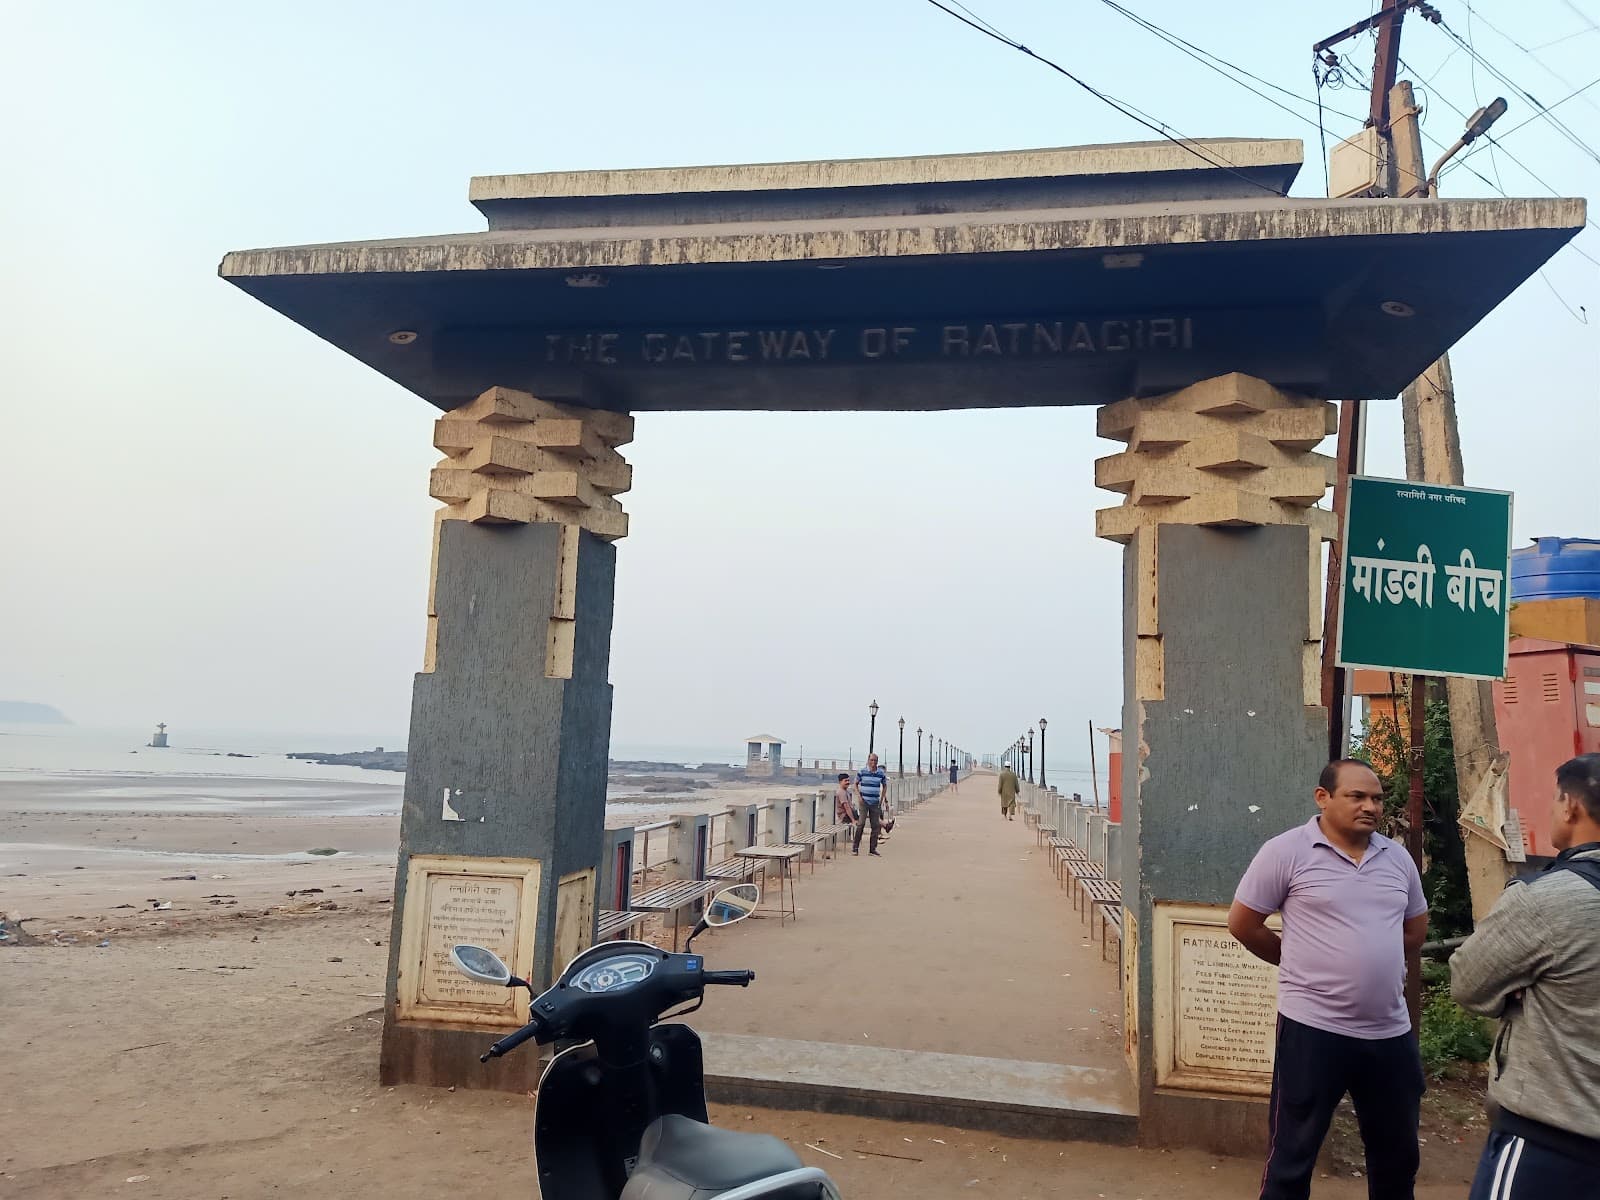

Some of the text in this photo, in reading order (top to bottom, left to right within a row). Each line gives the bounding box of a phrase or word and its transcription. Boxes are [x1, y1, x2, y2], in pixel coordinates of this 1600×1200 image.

[545, 317, 1194, 364] THE GATEWAY OF RATNAGIRI
[1395, 488, 1426, 501] रत्नागिरी
[1350, 537, 1504, 616] मांडवी बीच
[1183, 938, 1242, 951] RATNAGIRI
